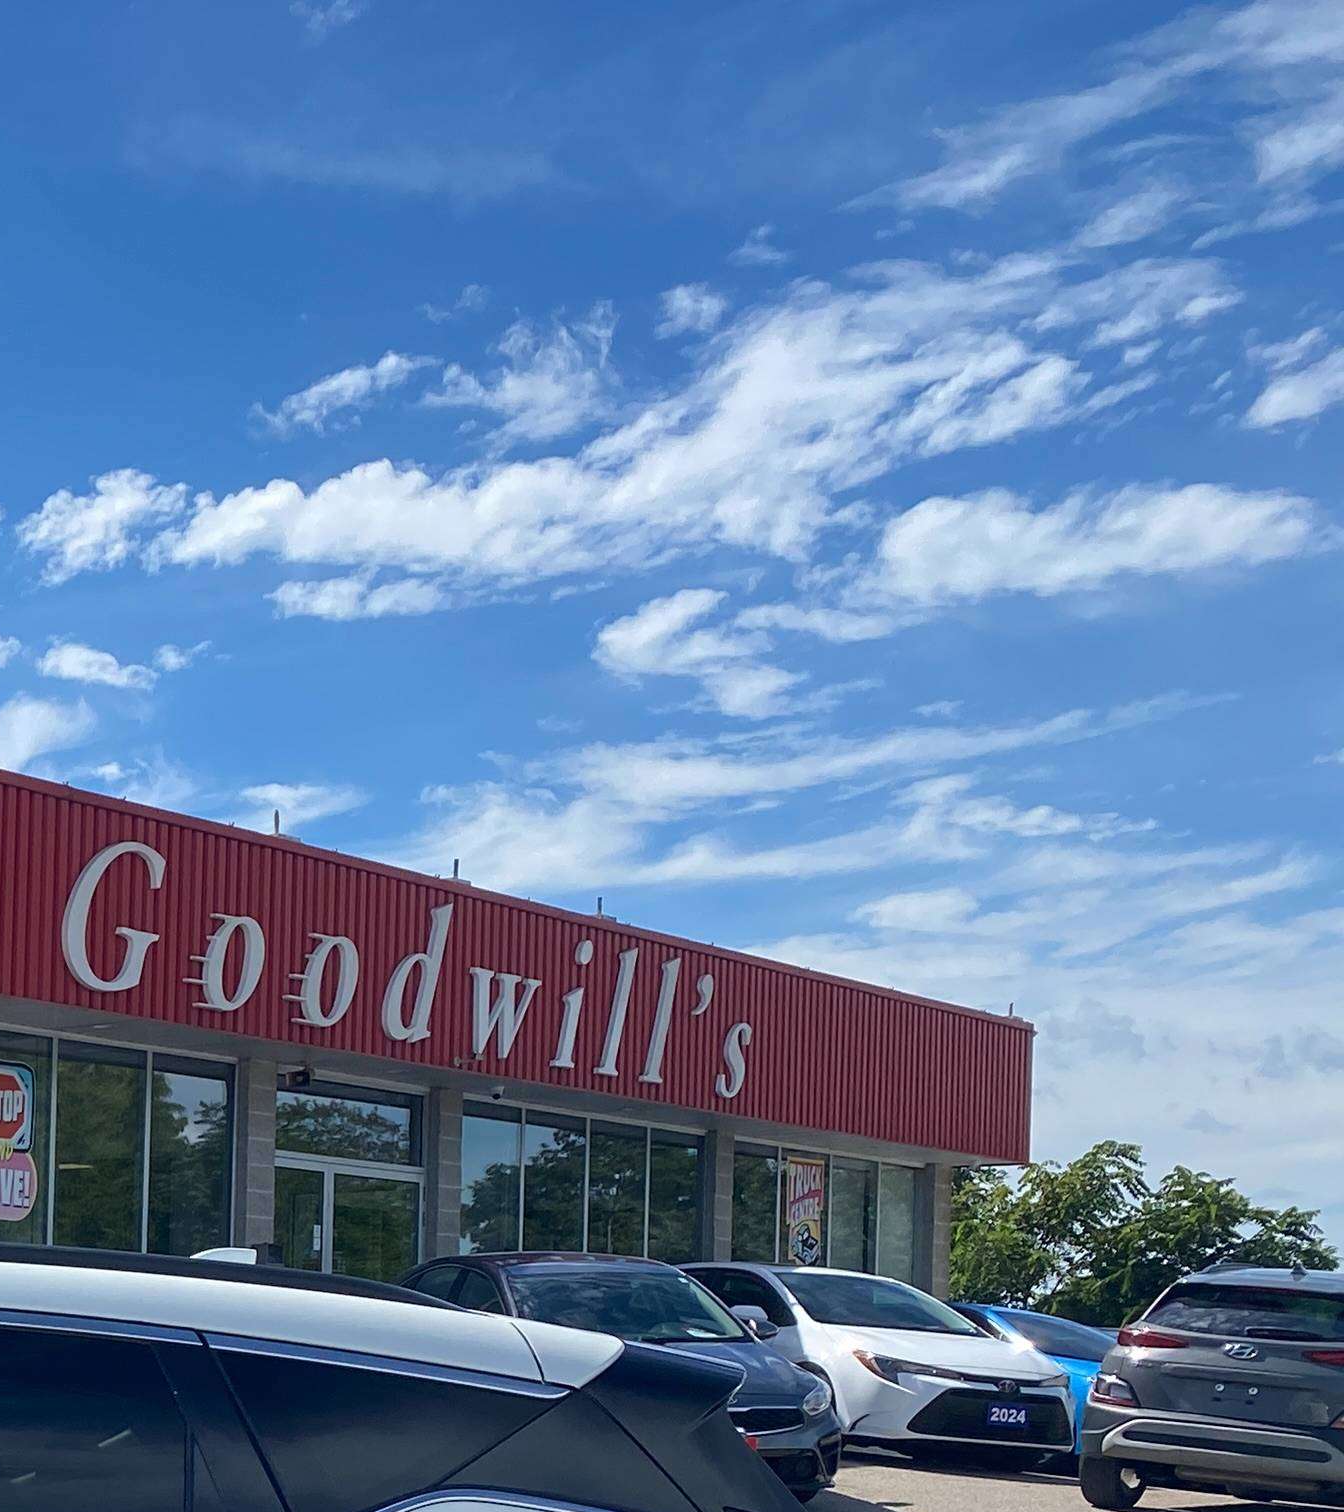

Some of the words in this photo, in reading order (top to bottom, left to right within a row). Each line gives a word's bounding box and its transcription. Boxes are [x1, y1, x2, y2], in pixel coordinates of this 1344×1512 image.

[61, 841, 752, 1100] Goodwill's
[789, 1163, 822, 1200] TRUCK
[990, 1407, 1026, 1424] 2024
